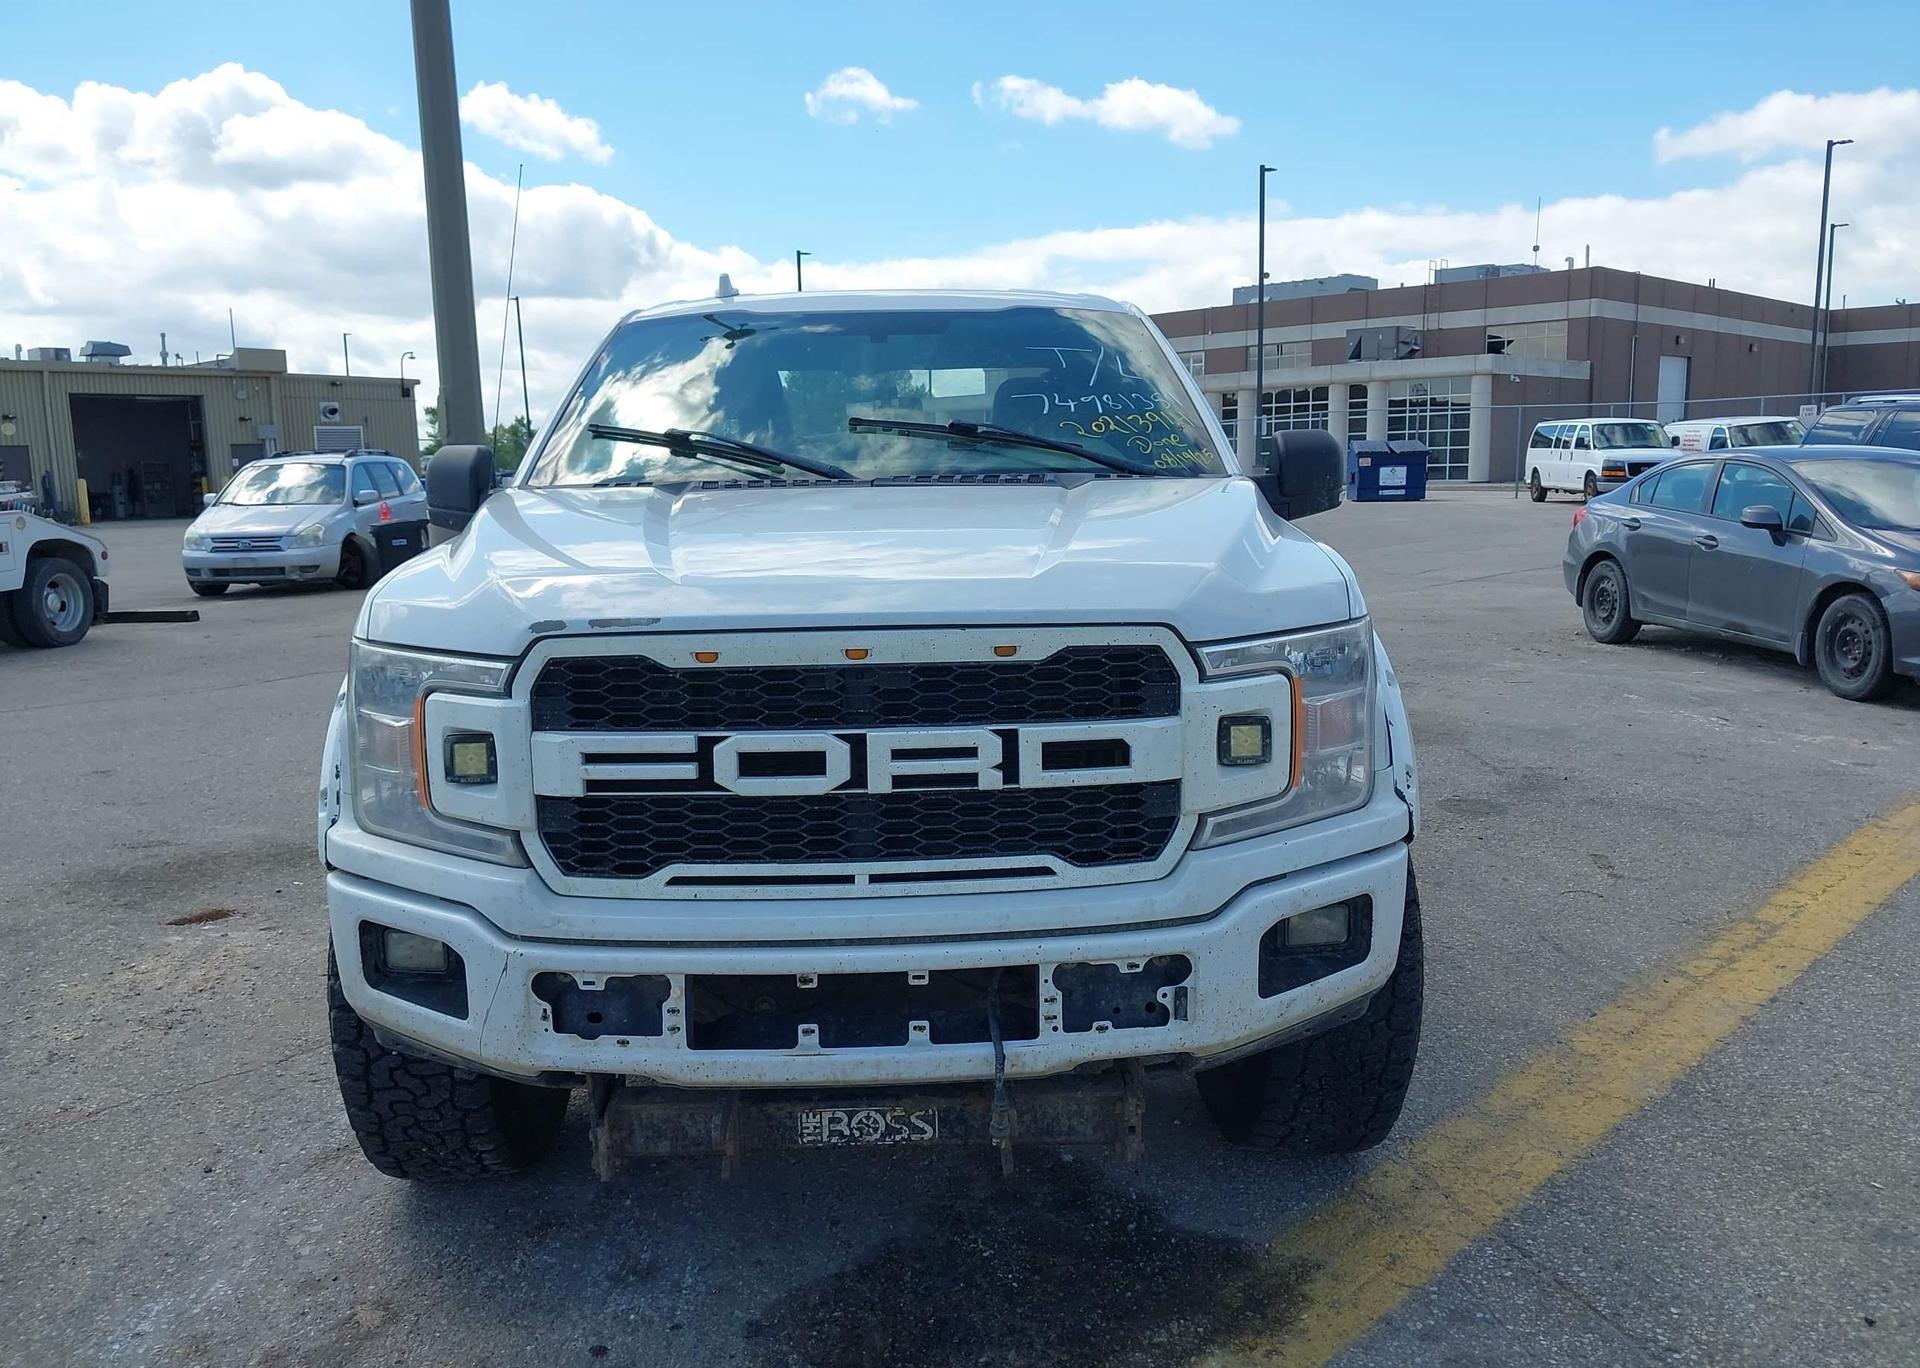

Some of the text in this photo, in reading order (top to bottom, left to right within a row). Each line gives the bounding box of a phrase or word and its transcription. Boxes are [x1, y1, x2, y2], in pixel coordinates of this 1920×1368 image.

[1127, 434, 1187, 454] Done
[532, 724, 1172, 797] FORD
[821, 1109, 934, 1143] BOSS
